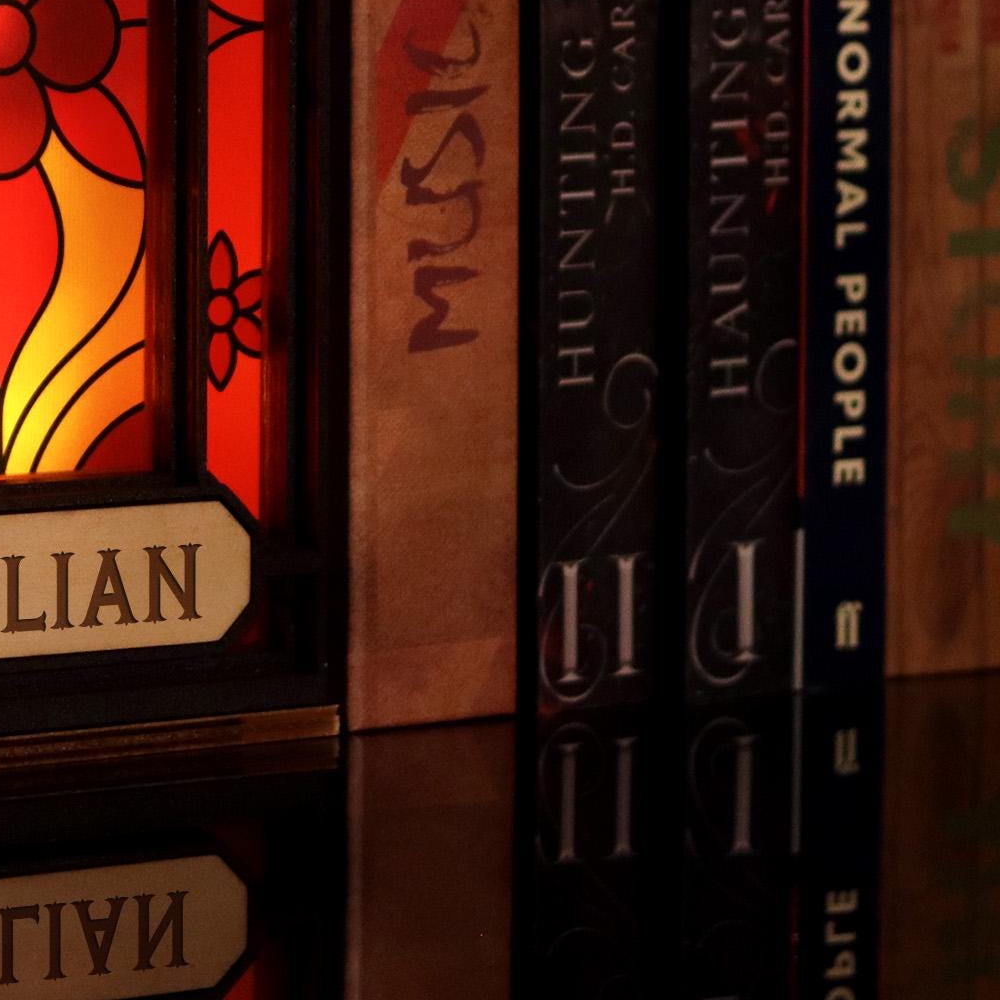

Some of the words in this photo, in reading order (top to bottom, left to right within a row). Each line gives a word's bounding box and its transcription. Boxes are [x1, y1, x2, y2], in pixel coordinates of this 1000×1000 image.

[400, 18, 489, 353] MUSIC
[557, 36, 598, 388] HUNTING
[709, 6, 750, 399] HAUNTING
[830, 271, 868, 488] PEOPLE
